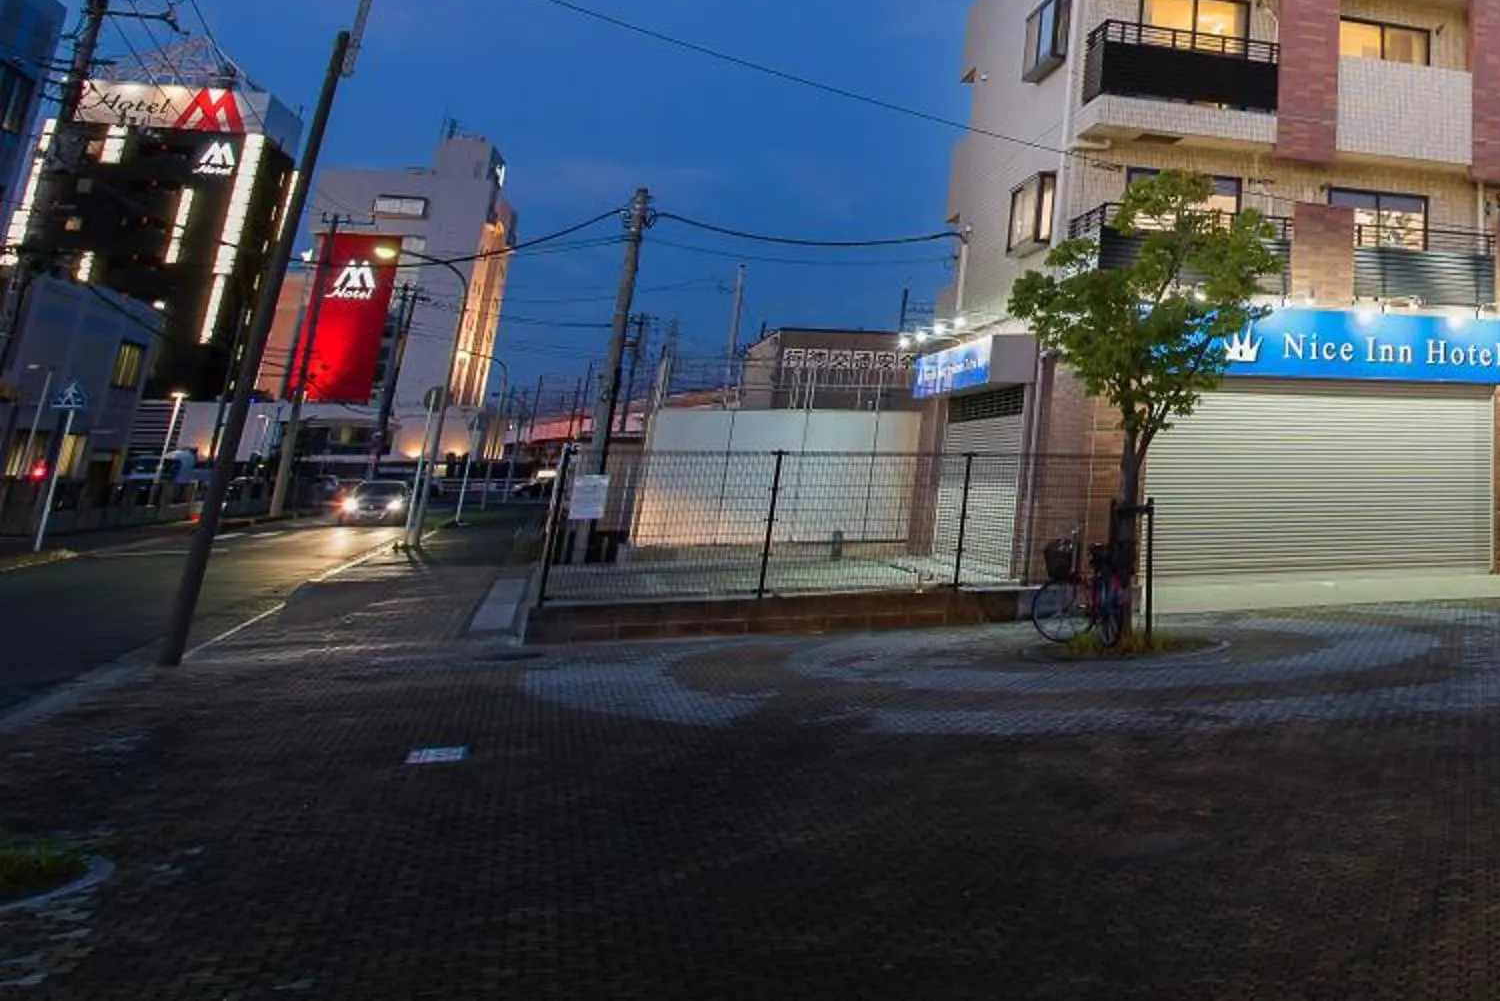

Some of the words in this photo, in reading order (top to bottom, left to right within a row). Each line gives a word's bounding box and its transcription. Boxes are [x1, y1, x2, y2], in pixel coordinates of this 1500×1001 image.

[84, 93, 170, 114] Hotel
[323, 286, 374, 299] Hotel
[1282, 332, 1354, 361] Nice
[1365, 336, 1412, 363] Inn
